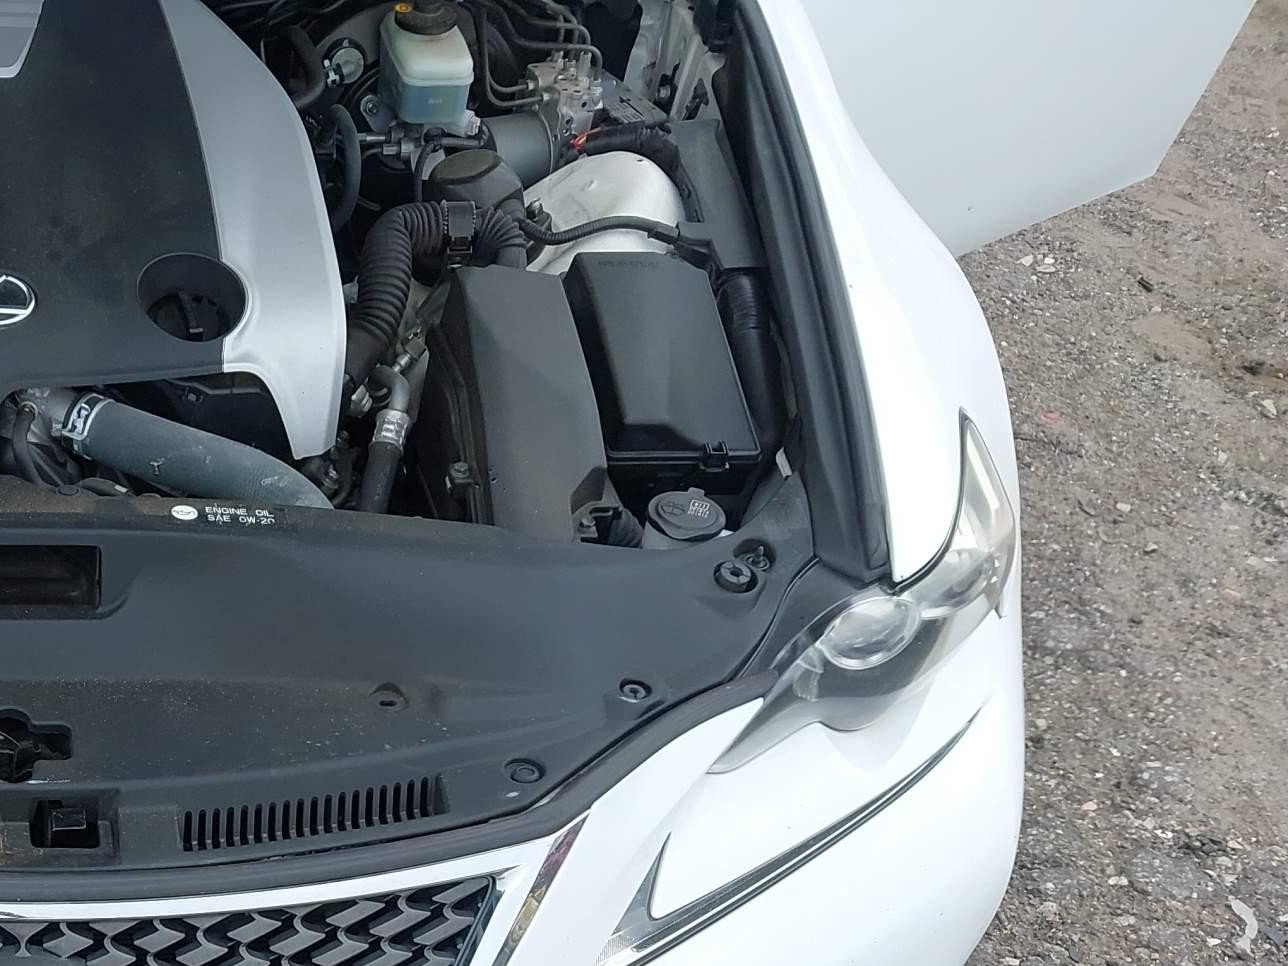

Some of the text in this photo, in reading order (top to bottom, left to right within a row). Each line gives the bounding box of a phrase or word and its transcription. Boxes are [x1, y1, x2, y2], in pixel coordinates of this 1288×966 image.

[205, 506, 275, 518] ENGINE OIL
[207, 514, 232, 523] SAE
